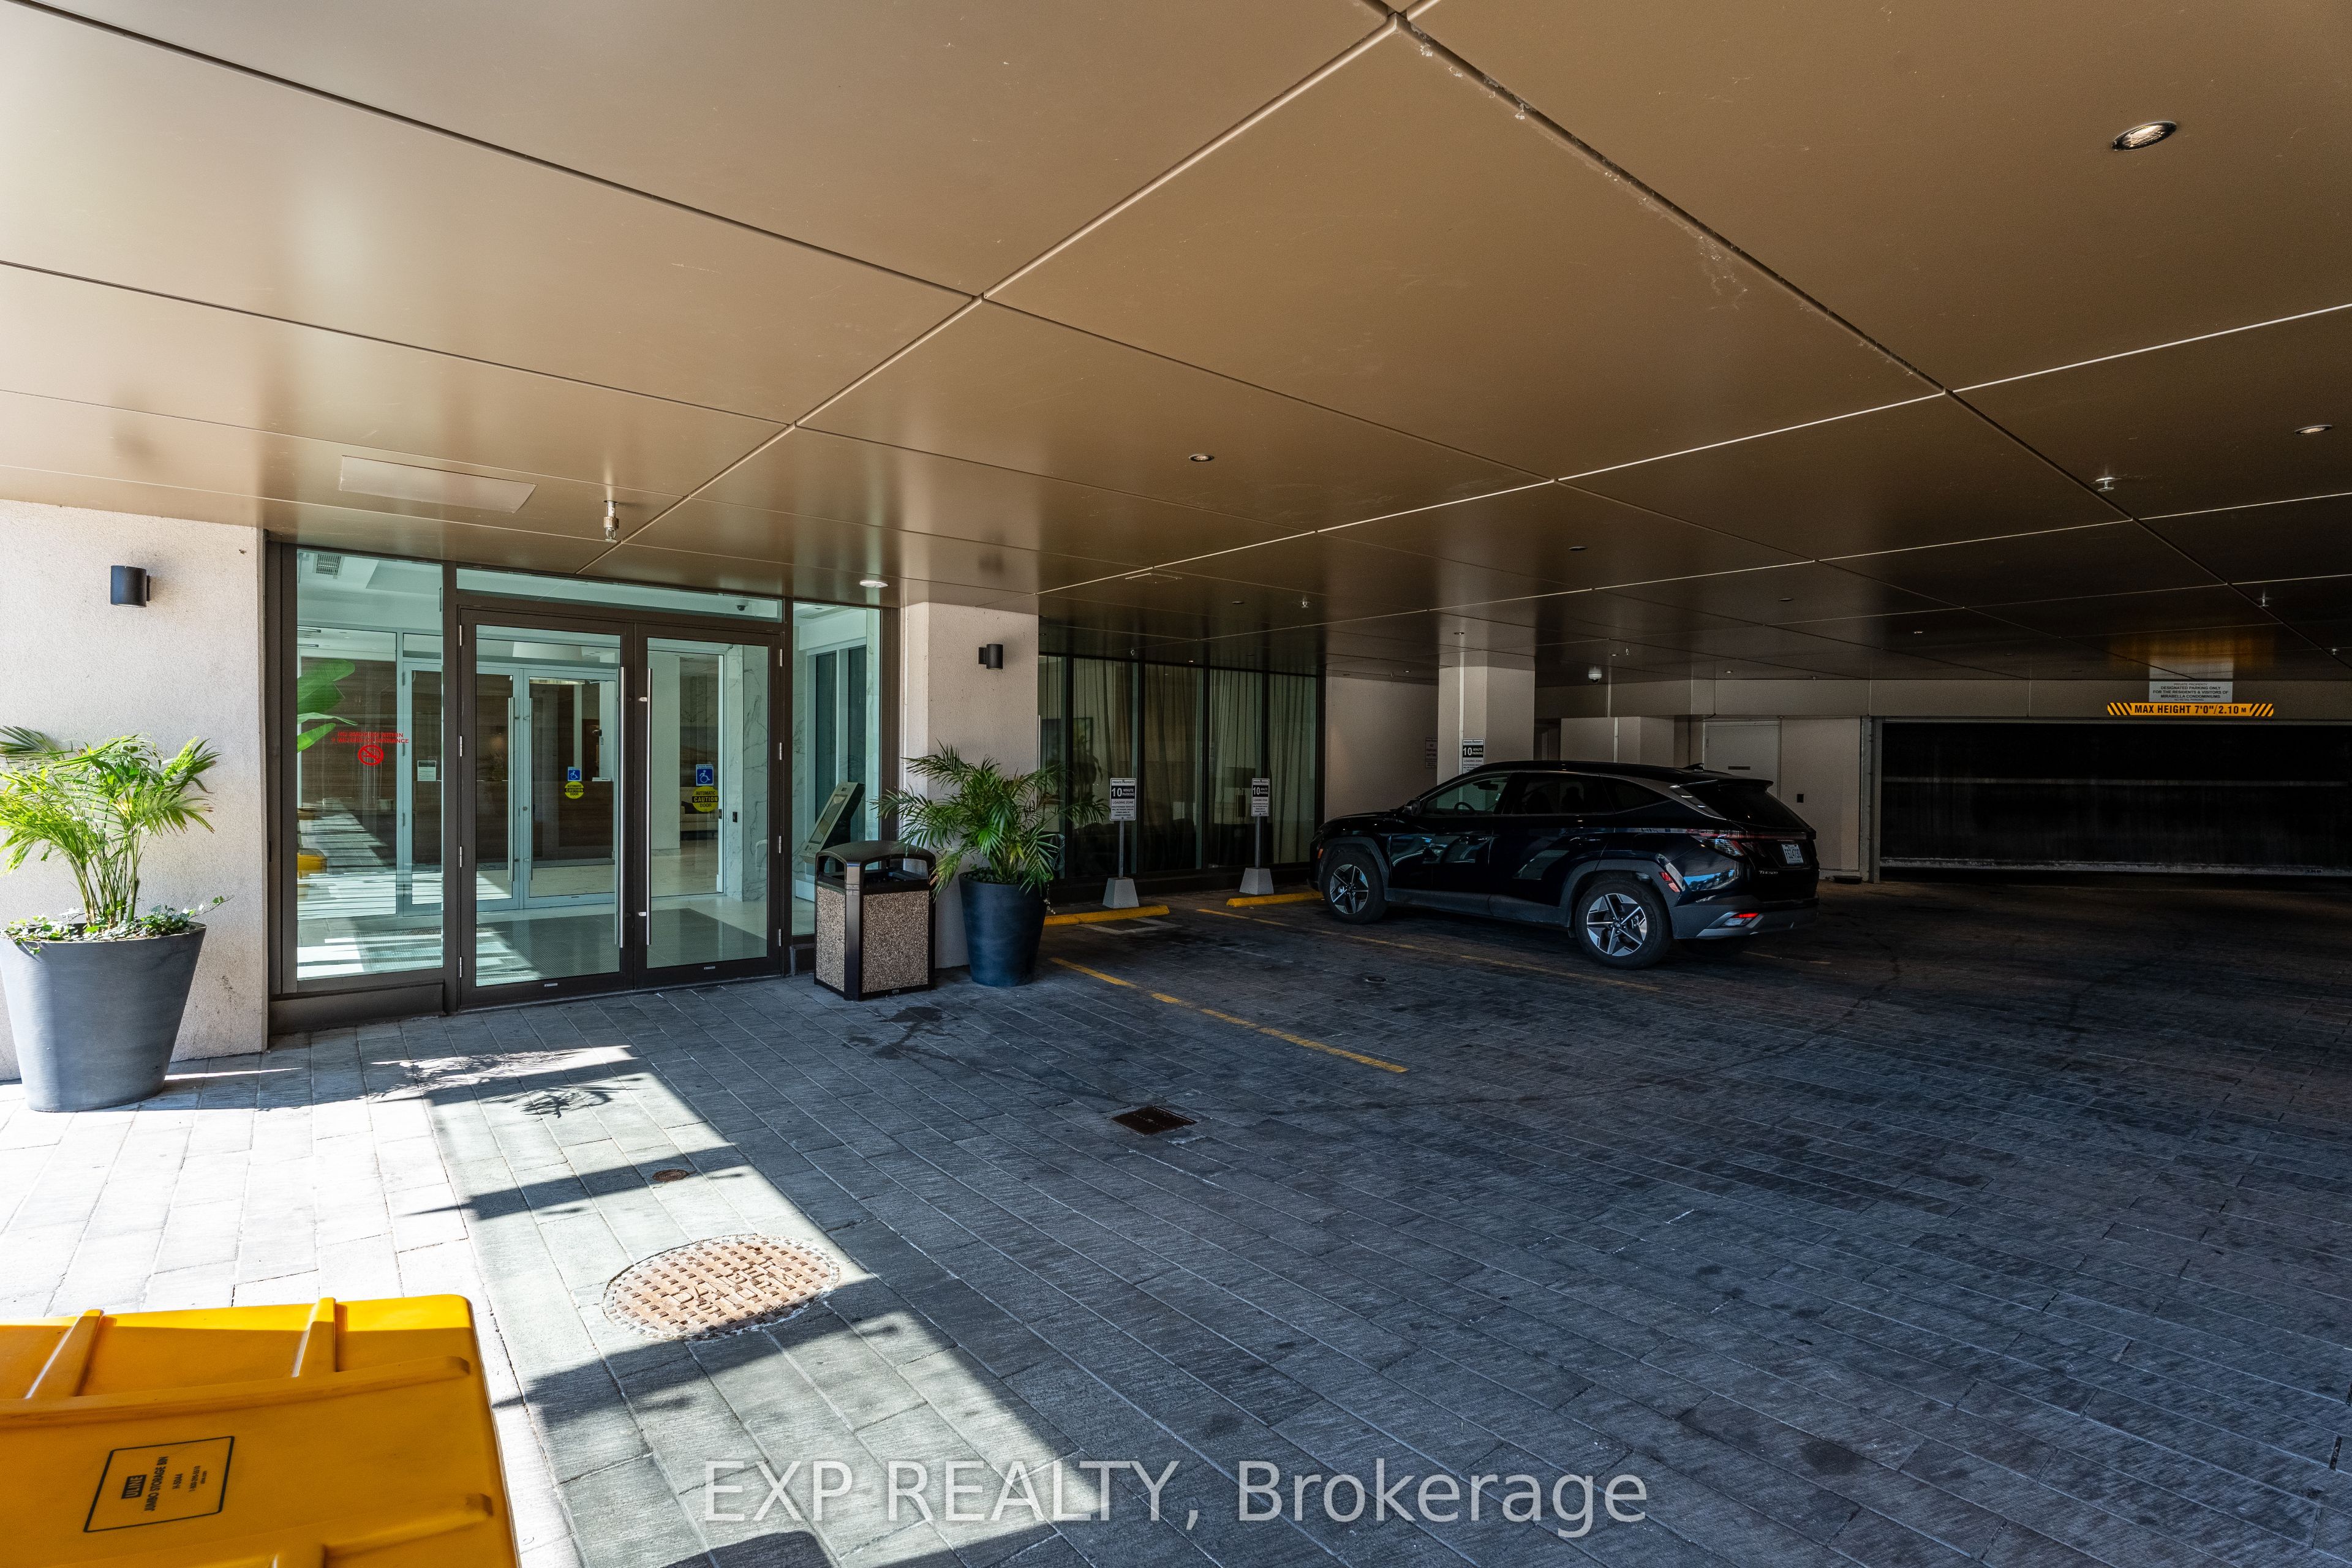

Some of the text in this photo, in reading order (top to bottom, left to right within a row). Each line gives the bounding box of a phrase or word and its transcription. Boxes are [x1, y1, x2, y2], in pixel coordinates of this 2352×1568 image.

[2135, 705, 2154, 714] MAX
[2157, 705, 2191, 714] HEIGHT
[1112, 788, 1122, 797] 10
[1253, 786, 1261, 795] 10
[669, 1260, 783, 1305] DANGER
[696, 1273, 797, 1315] STORM
[124, 1476, 145, 1498] ULINE
[144, 1456, 169, 1512] JUMBO STORAGE BIN
[172, 1473, 183, 1489] H-5044
